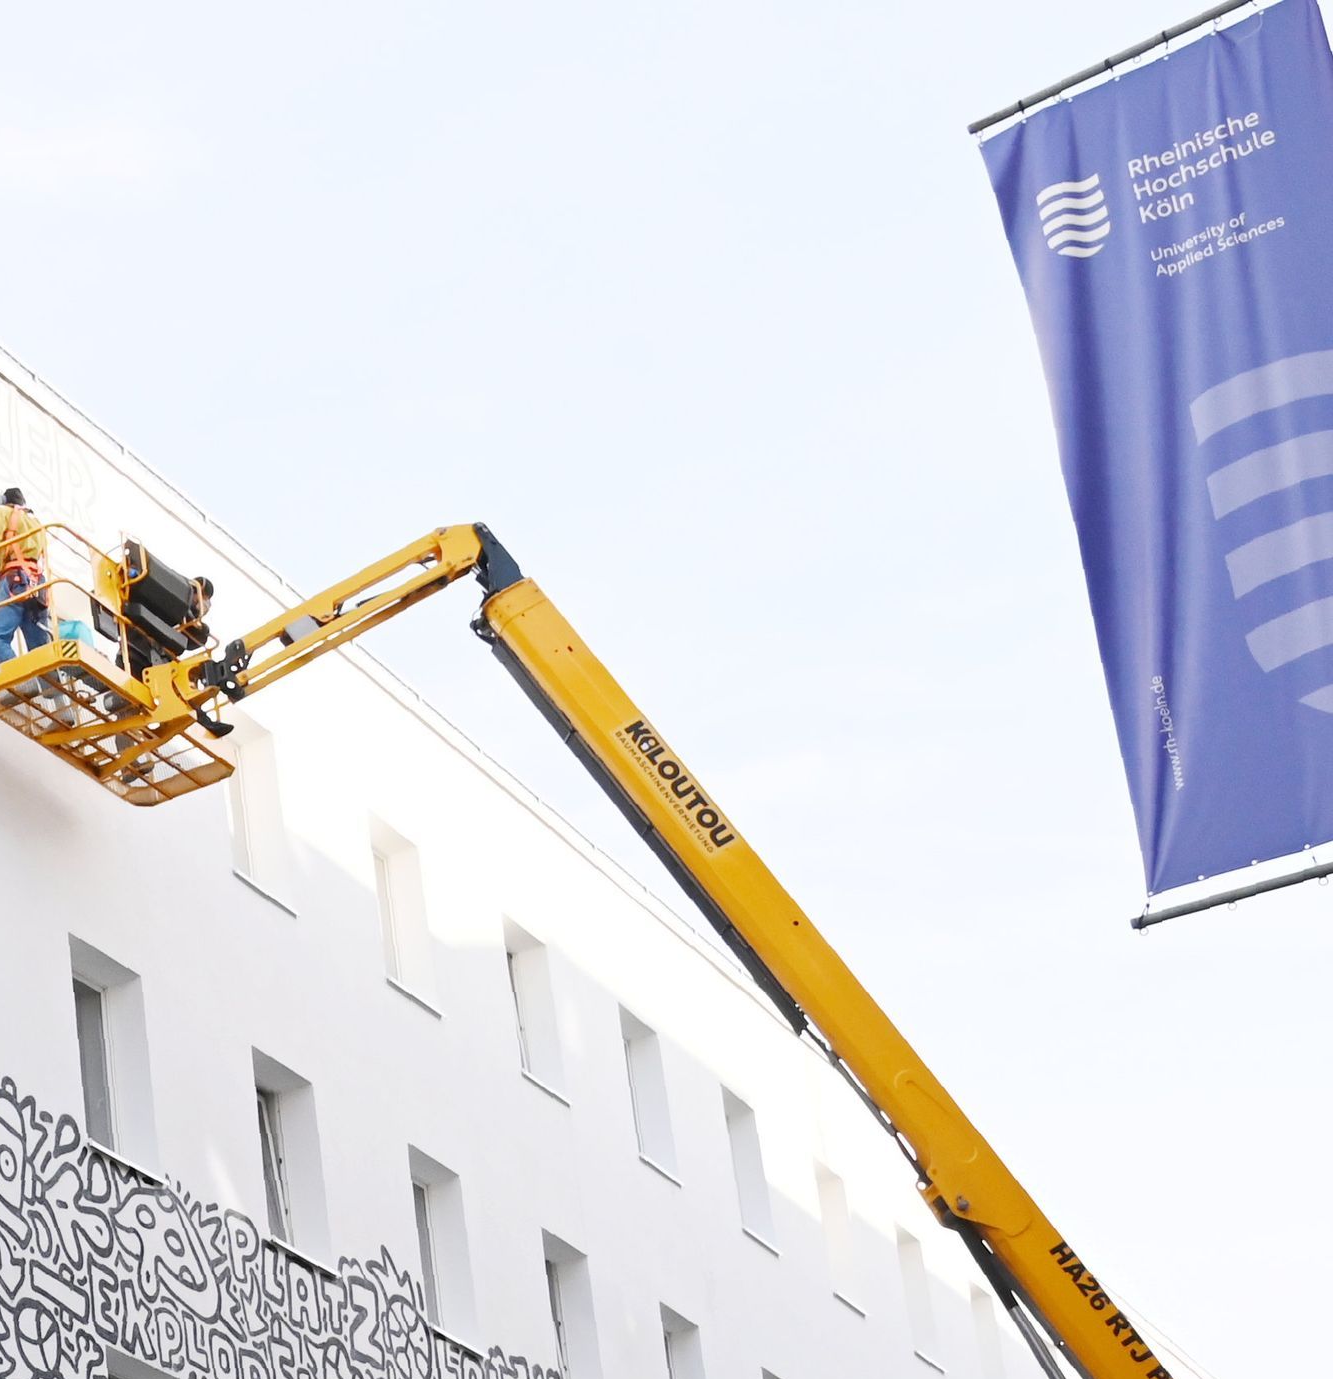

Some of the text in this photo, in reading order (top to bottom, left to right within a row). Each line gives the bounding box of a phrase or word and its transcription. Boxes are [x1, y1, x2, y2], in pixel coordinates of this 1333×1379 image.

[1127, 110, 1260, 179] Rheinische
[1134, 127, 1278, 202] Hochschule
[1138, 187, 1196, 224] Köln
[1150, 213, 1247, 263] University of
[1155, 217, 1285, 278] Applied Sciences
[1150, 674, 1185, 792] www.rh-koeln.de
[224, 1201, 385, 1375] PLATZ
[1050, 1241, 1111, 1311] HA26
[1106, 1312, 1154, 1363] RTJ
